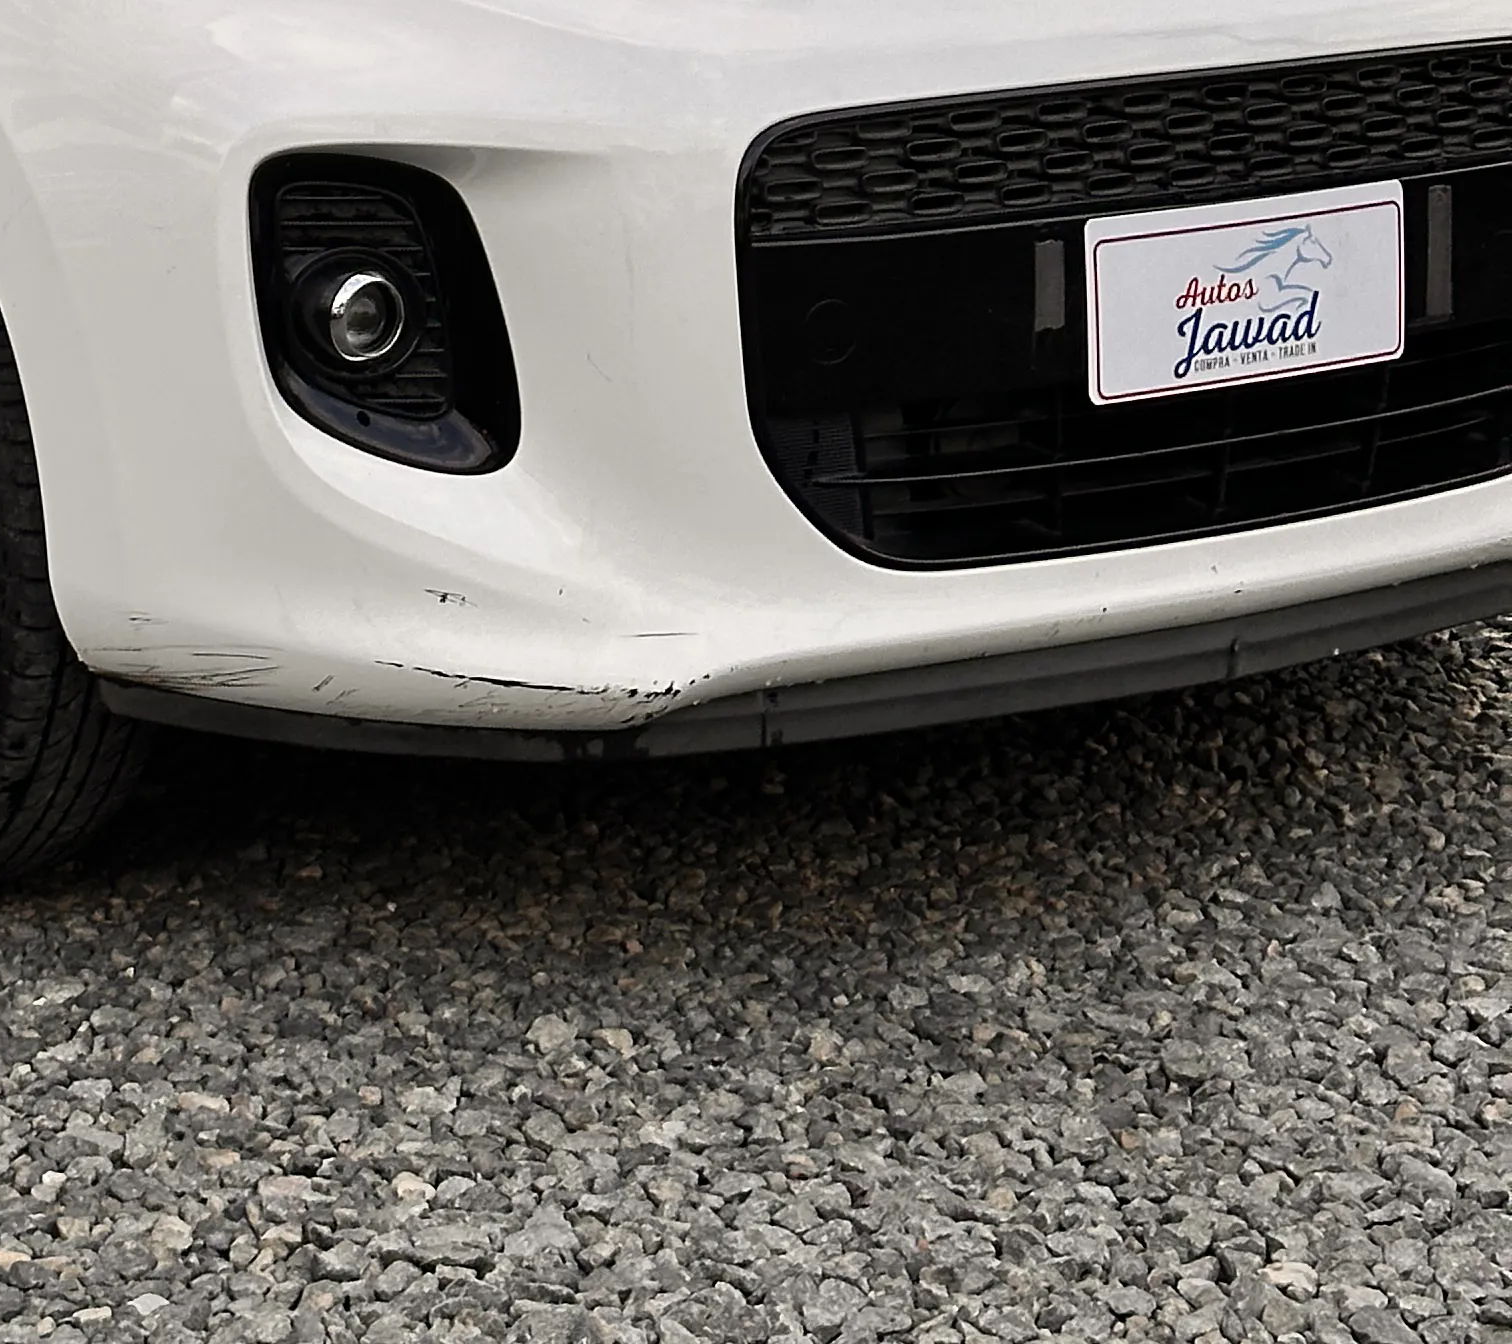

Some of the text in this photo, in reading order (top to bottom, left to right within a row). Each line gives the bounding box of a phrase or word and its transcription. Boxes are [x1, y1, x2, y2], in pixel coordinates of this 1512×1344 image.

[1175, 274, 1259, 309] Autos
[1173, 290, 1321, 379] Jawad
[1194, 342, 1317, 372] COMPRA VENTA TRADE IN
